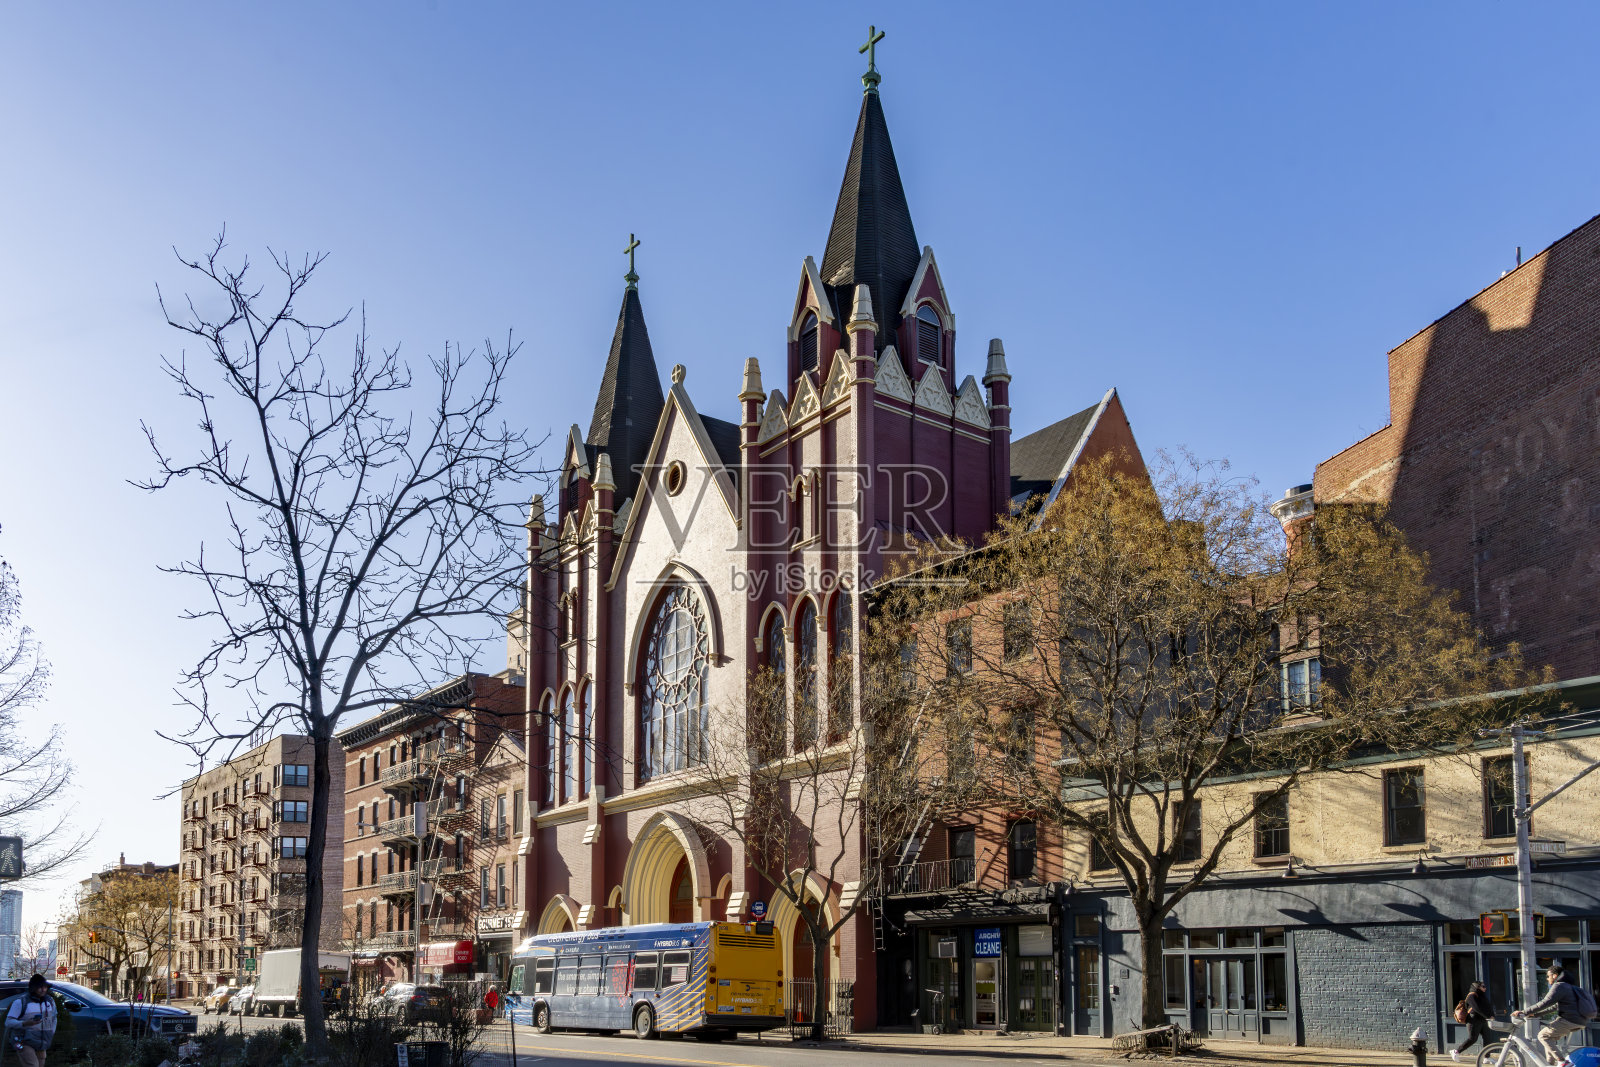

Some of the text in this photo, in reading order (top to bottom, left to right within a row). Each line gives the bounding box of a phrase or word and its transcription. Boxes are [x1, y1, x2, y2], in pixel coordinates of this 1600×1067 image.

[1466, 855, 1514, 868] CHRISTOPHER ST
[478, 917, 503, 929] GOURMET
[565, 934, 585, 944] energy
[587, 932, 599, 940] bus
